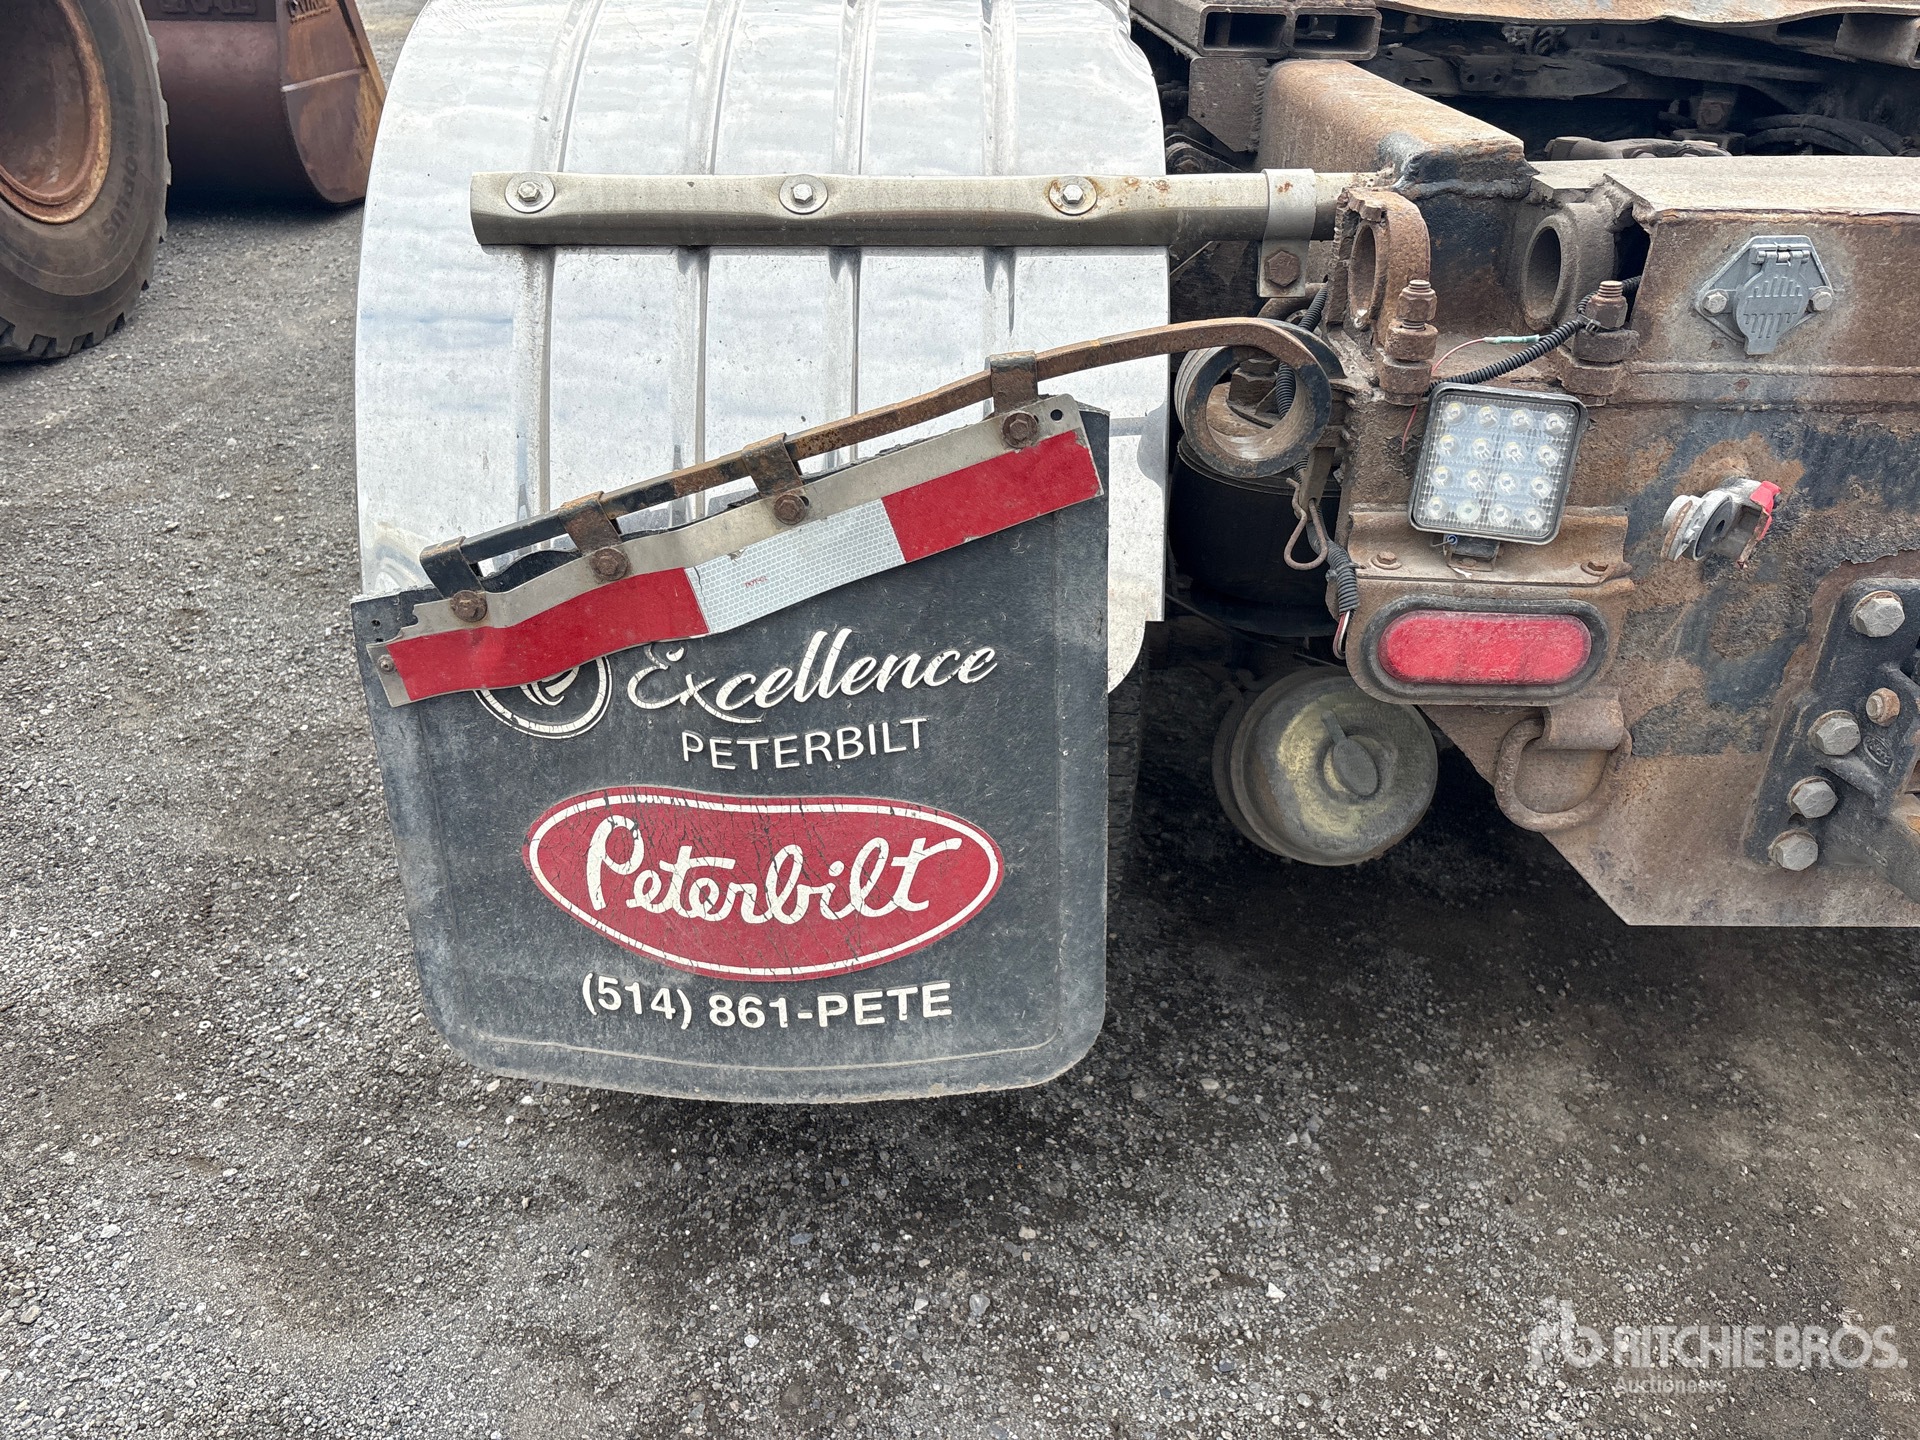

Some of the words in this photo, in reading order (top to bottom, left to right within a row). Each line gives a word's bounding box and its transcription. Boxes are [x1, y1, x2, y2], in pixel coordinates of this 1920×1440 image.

[627, 627, 998, 724] Excellence
[681, 716, 930, 771] PETERBILT
[585, 814, 963, 925] Peterbilt
[581, 972, 693, 1030] (514)
[708, 982, 953, 1029] 861-PETE
